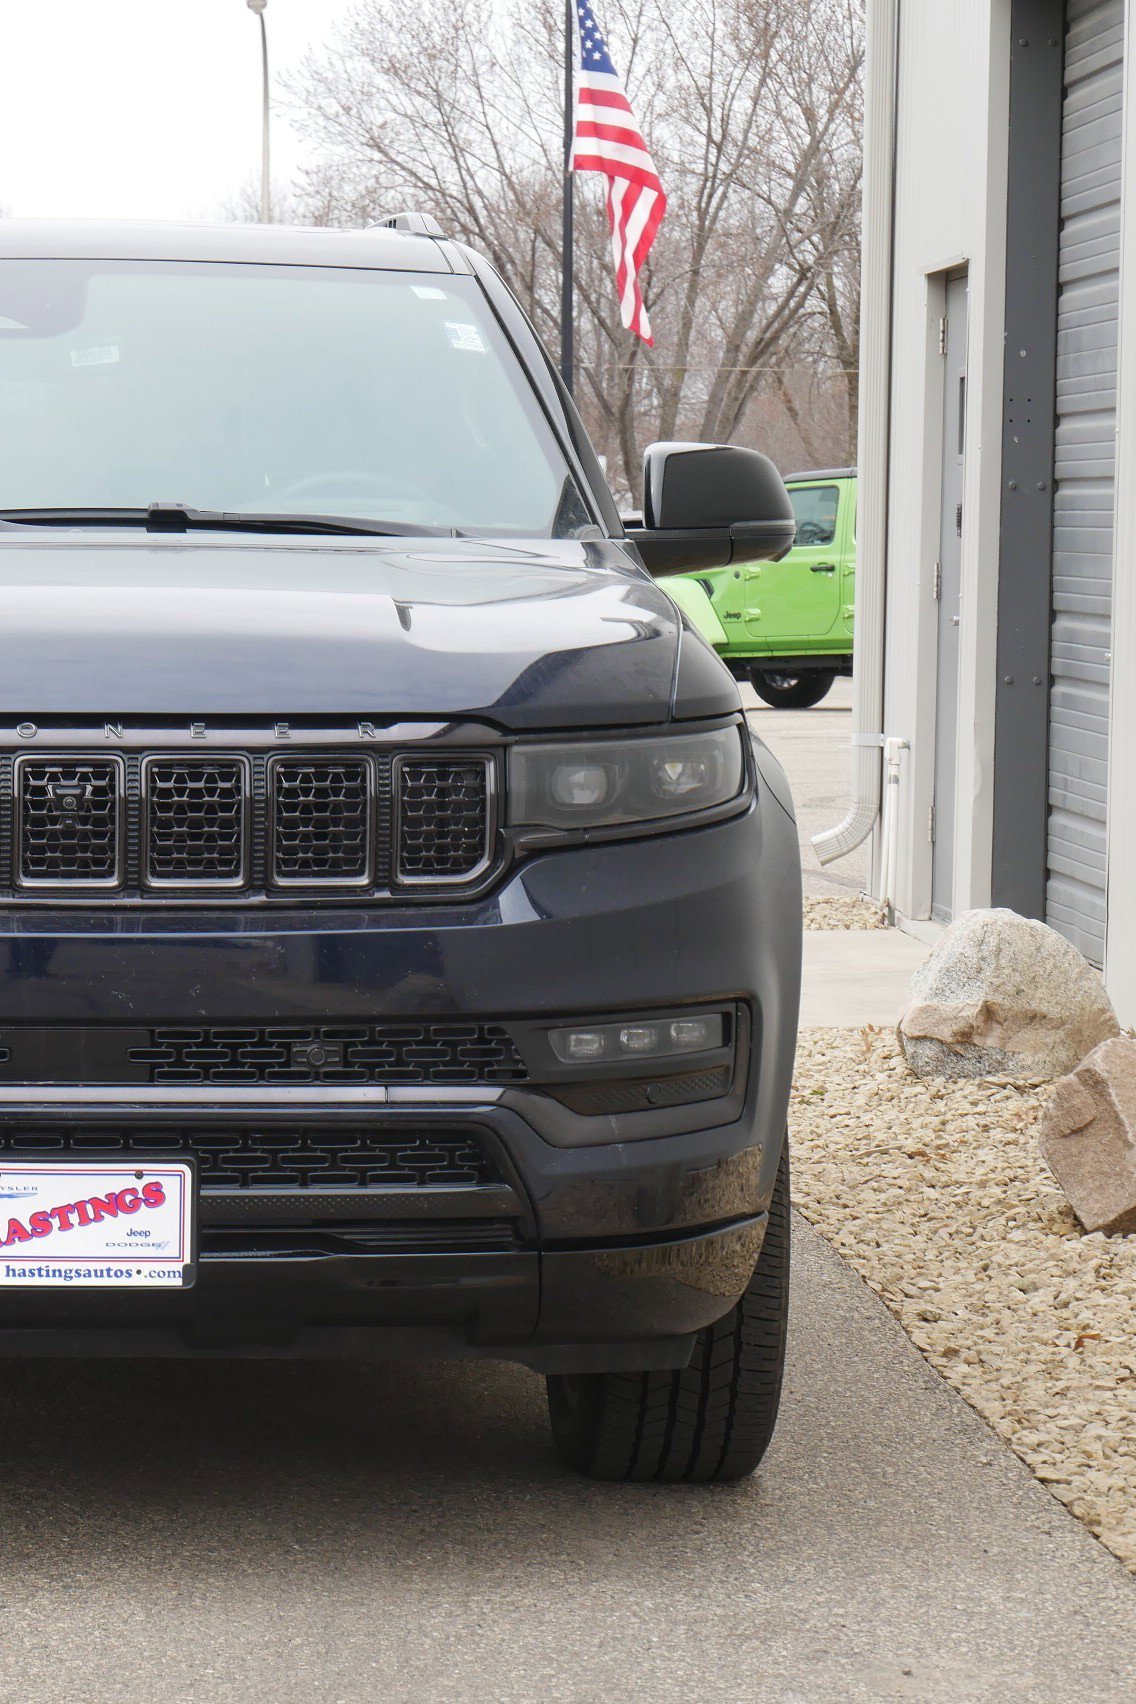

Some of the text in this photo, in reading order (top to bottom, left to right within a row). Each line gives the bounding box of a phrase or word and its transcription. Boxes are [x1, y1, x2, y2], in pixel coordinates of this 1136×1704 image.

[723, 611, 742, 620] Jeep
[126, 1228, 151, 1238] Jeep
[5, 1265, 133, 1281] hastingsautos
